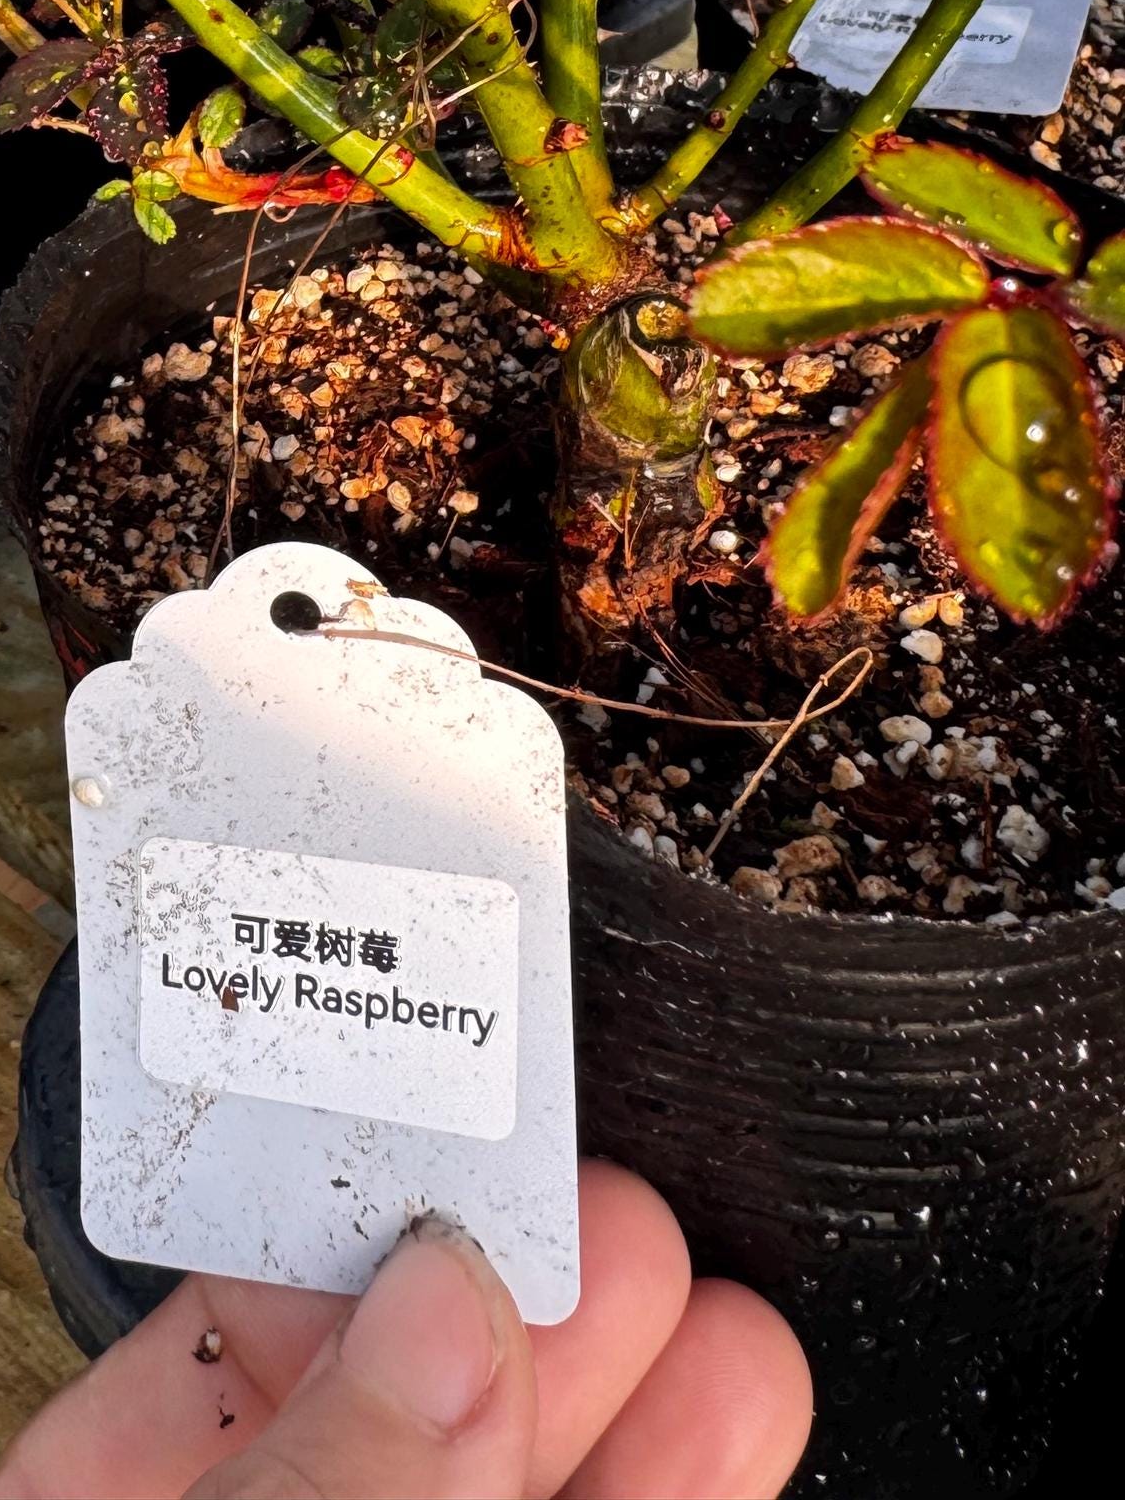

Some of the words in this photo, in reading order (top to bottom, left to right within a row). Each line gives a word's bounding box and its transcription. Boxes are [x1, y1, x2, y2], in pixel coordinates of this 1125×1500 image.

[230, 913, 401, 973] 可爱树莓
[161, 953, 284, 1013] Lovely
[295, 973, 499, 1047] Raspberry
